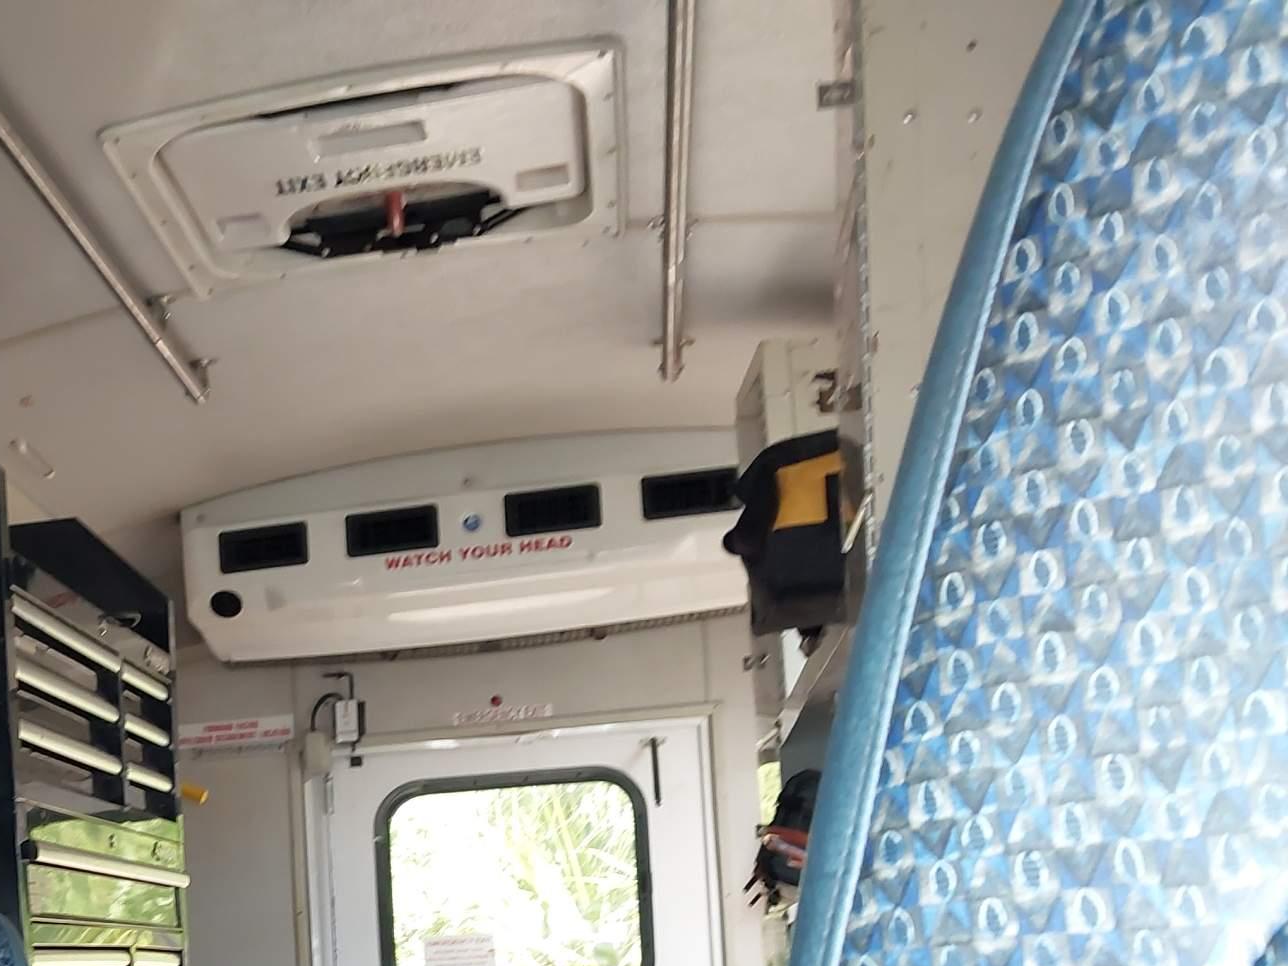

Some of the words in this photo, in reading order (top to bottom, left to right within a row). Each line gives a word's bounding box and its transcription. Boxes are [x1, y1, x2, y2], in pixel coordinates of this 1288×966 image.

[275, 172, 327, 196] EXIT
[334, 148, 484, 188] EMERGENCY
[384, 550, 453, 570] WATCH
[459, 542, 514, 561] YOUR
[519, 535, 574, 553] HEAD
